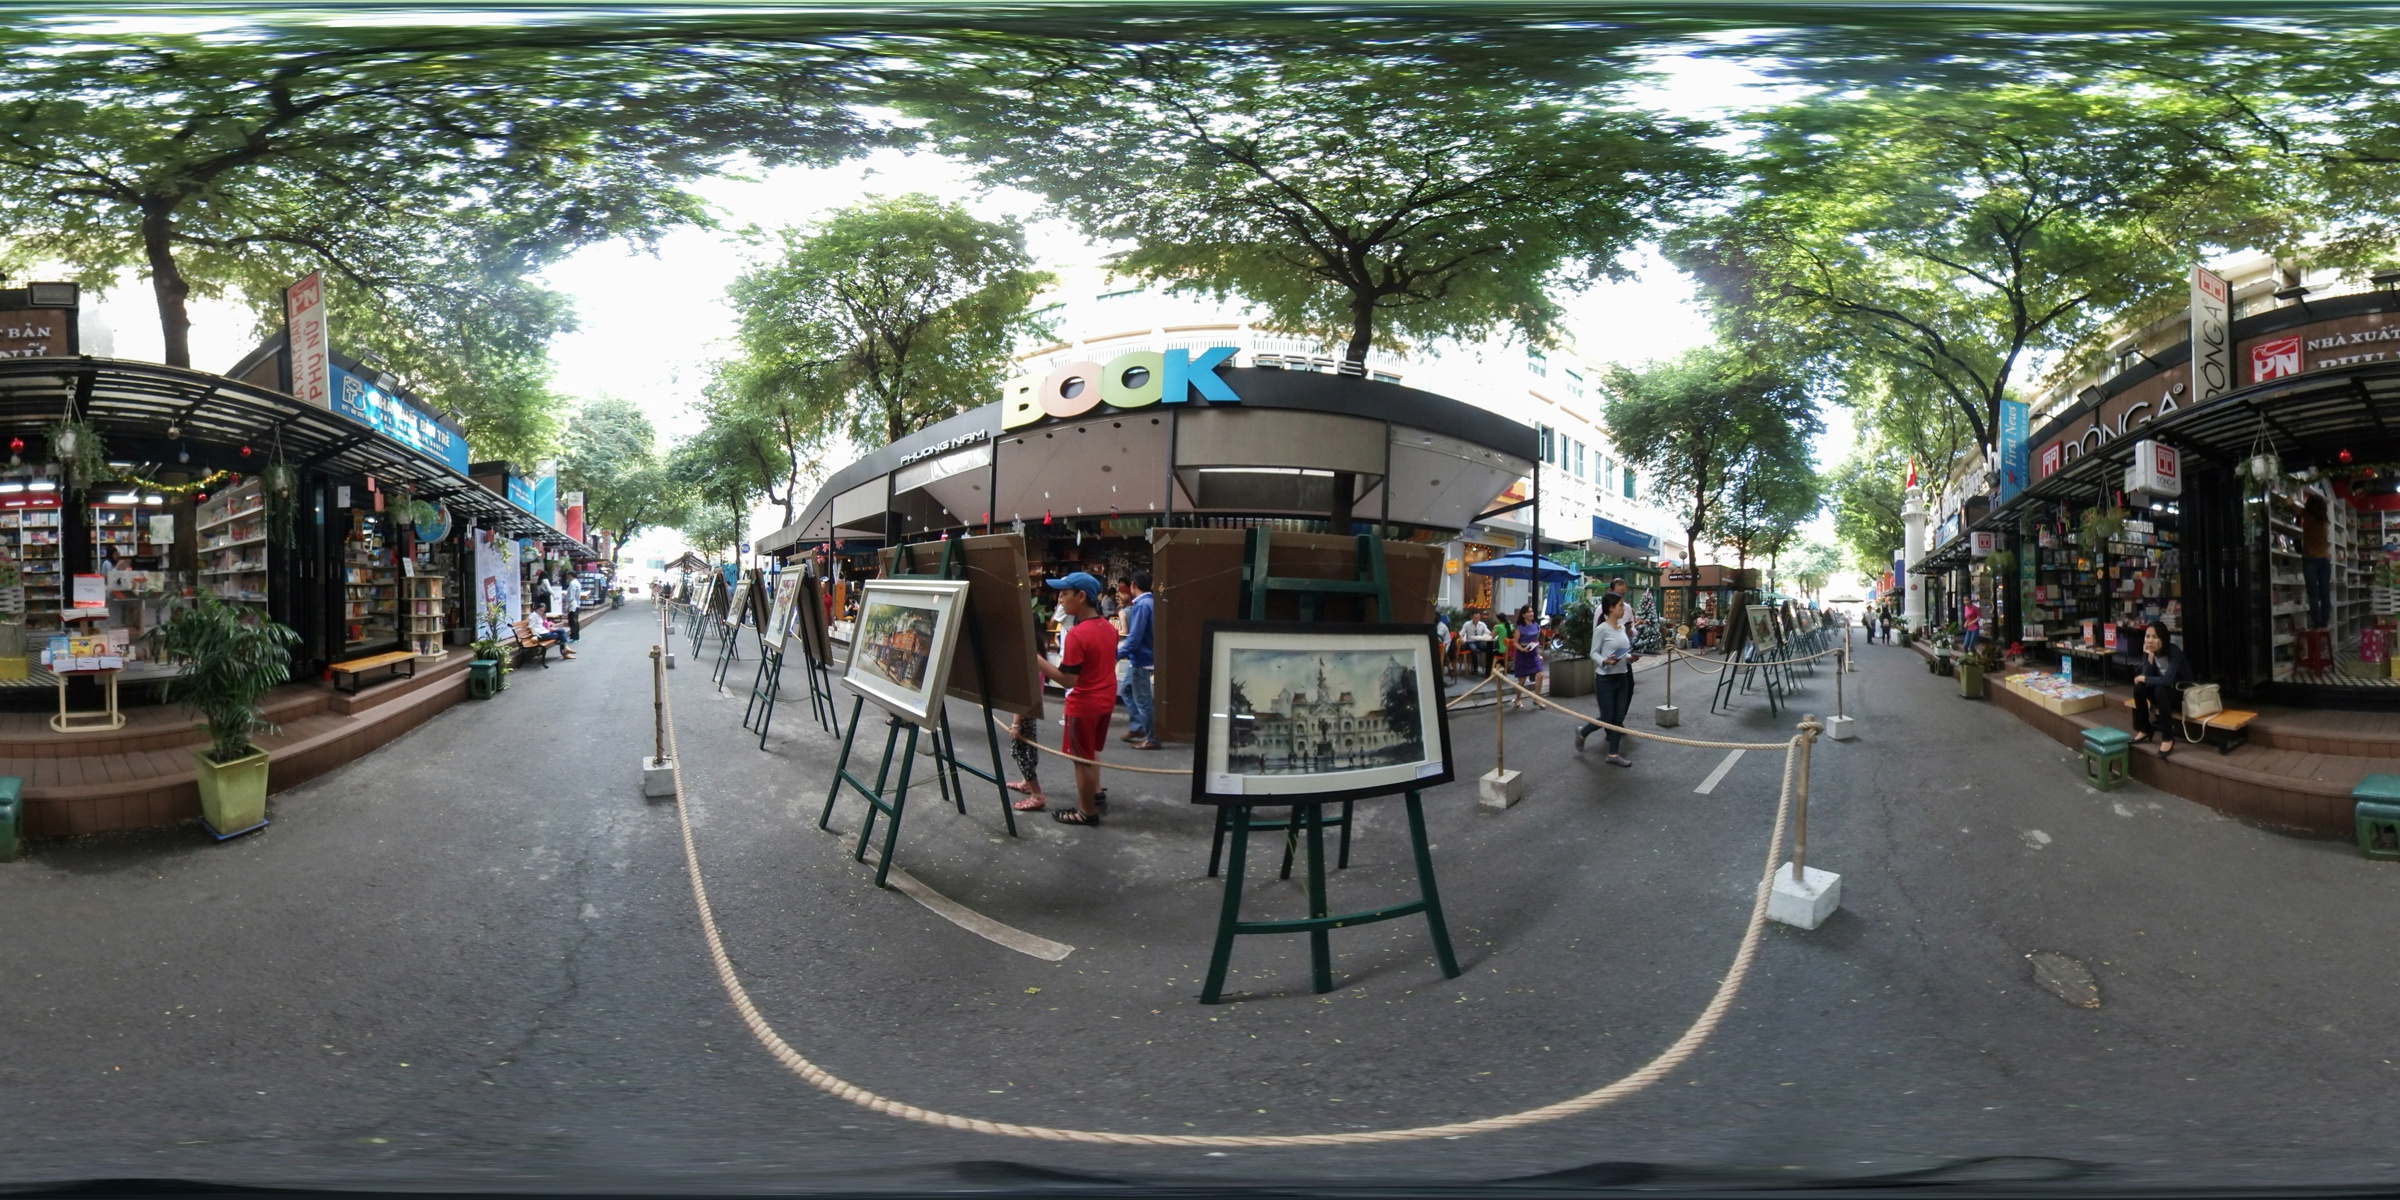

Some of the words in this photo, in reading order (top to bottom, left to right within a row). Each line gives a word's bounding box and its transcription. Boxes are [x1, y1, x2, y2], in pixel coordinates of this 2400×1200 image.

[8, 322, 51, 338] BẢN
[2307, 333, 2347, 351] NHÀ
[2253, 352, 2300, 383] PN
[1000, 345, 1241, 431] BOOK
[2004, 406, 2017, 436] News
[950, 428, 985, 446] NAM
[2005, 438, 2017, 467] First
